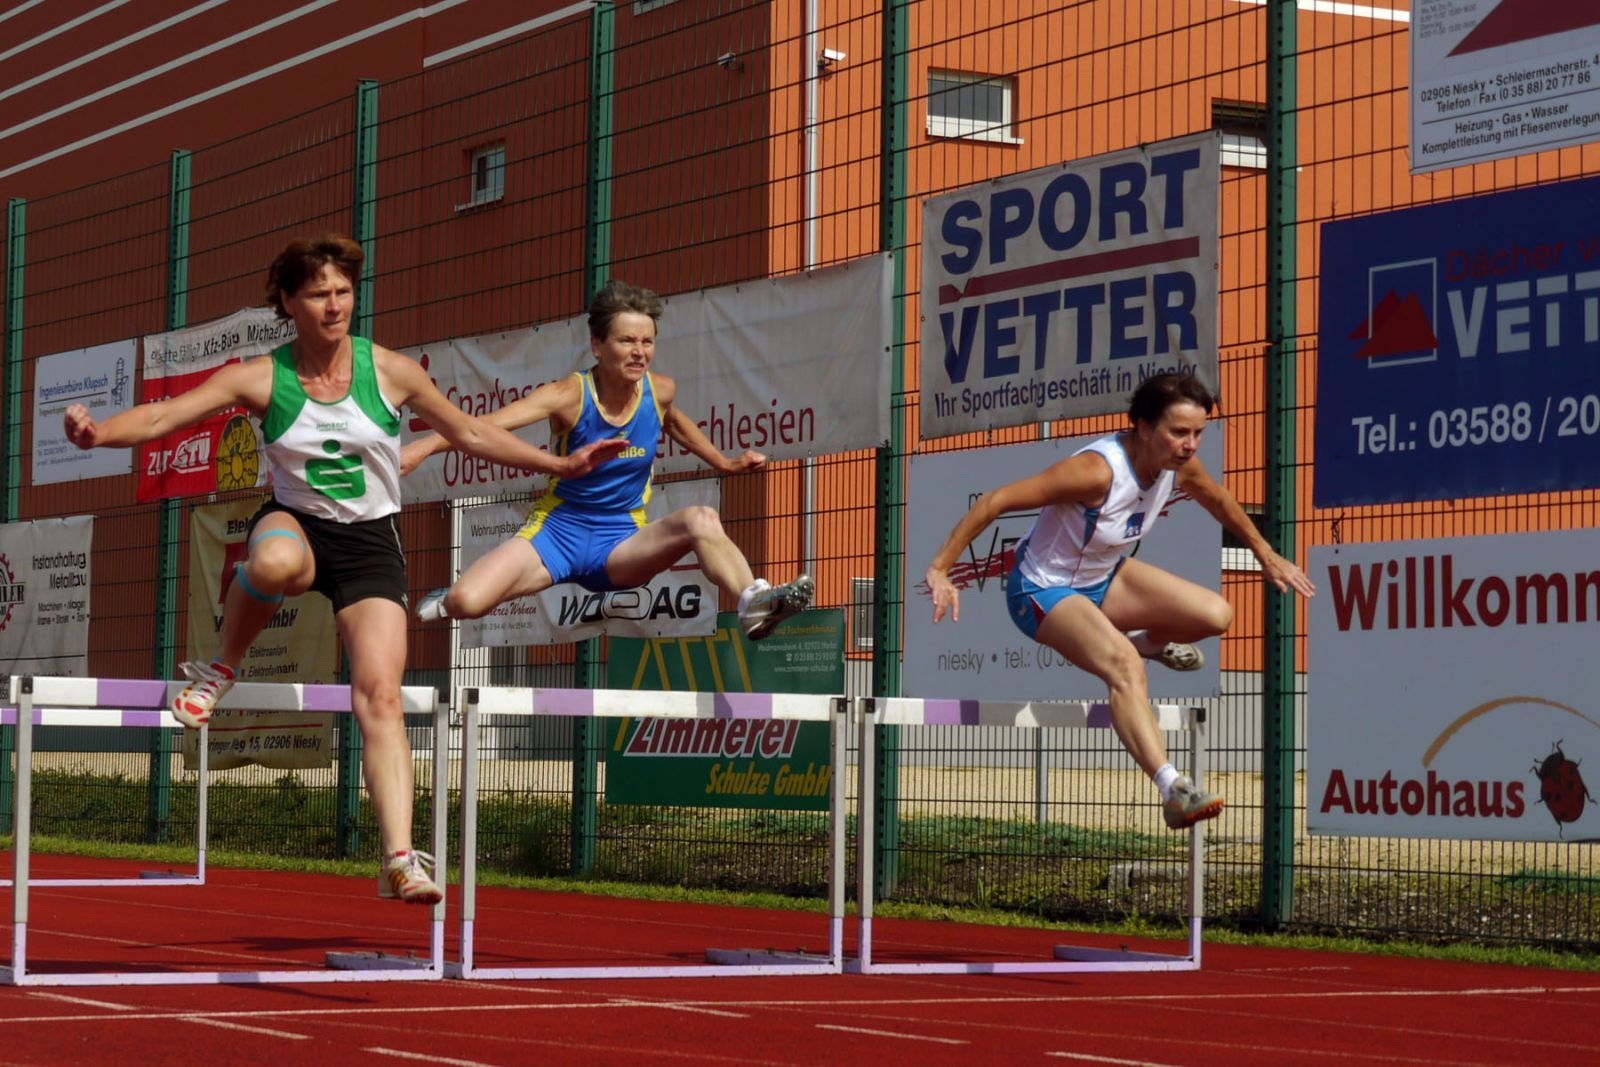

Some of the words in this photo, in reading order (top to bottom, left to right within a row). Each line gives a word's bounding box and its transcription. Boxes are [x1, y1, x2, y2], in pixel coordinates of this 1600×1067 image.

[1421, 85, 1450, 102] 02906
[1452, 79, 1486, 96] Niesky
[1495, 58, 1590, 87] Schleiermacherstr.
[1436, 96, 1471, 113] Telefon
[1479, 92, 1497, 104] Fax
[1499, 87, 1509, 100] (0
[1511, 84, 1524, 98] 35
[1526, 80, 1543, 95] 88)
[1545, 77, 1559, 91] 20
[1561, 74, 1575, 87] 77
[1577, 71, 1591, 84] 86
[1455, 117, 1494, 135] Heizung
[1502, 111, 1522, 126] Gas
[1531, 104, 1569, 119] Wasser
[1422, 129, 1501, 155] Komplettleistung
[1503, 126, 1518, 138] mit
[941, 148, 1201, 275] SPORT
[1578, 238, 1600, 263] v
[247, 322, 282, 342] Michael
[939, 272, 1199, 384] VETTER
[935, 392, 957, 418] Ihr
[961, 368, 1112, 418] Sportfachgeschäft
[1116, 366, 1132, 392] in
[1351, 413, 1417, 456] Tel.:
[937, 648, 985, 673] niesky
[263, 735, 291, 750] 02906
[292, 734, 323, 752] Niesky
[705, 761, 770, 795] Schulze
[773, 763, 831, 796] GmbH
[1320, 769, 1525, 818] Autohaus
